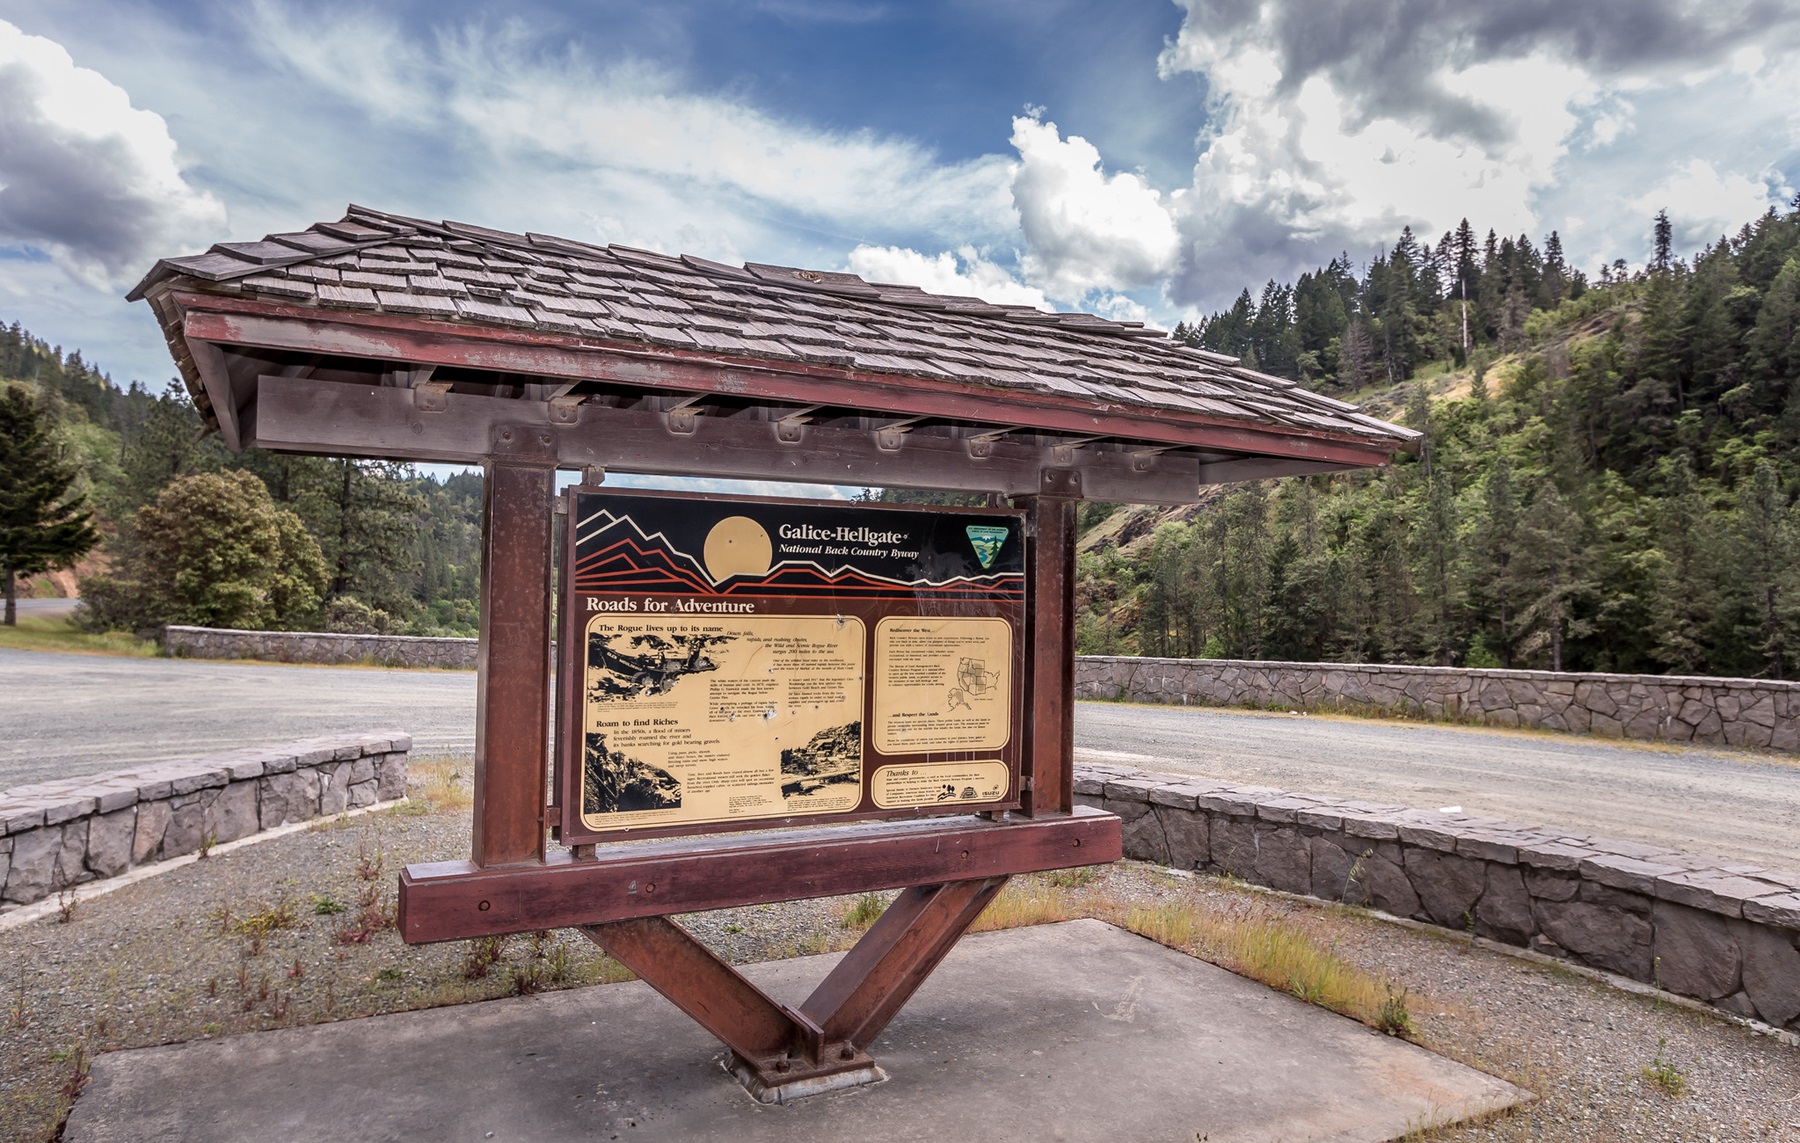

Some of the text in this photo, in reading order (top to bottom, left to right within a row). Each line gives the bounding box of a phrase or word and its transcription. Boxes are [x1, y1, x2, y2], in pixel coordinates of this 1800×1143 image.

[779, 524, 901, 547] Galice-Hellgate
[779, 544, 919, 560] National Back Country Byway
[586, 597, 755, 613] Roads for Adventure
[599, 624, 614, 632] The
[618, 625, 643, 633] Rogue
[633, 719, 650, 727] find
[653, 718, 678, 726] Riches
